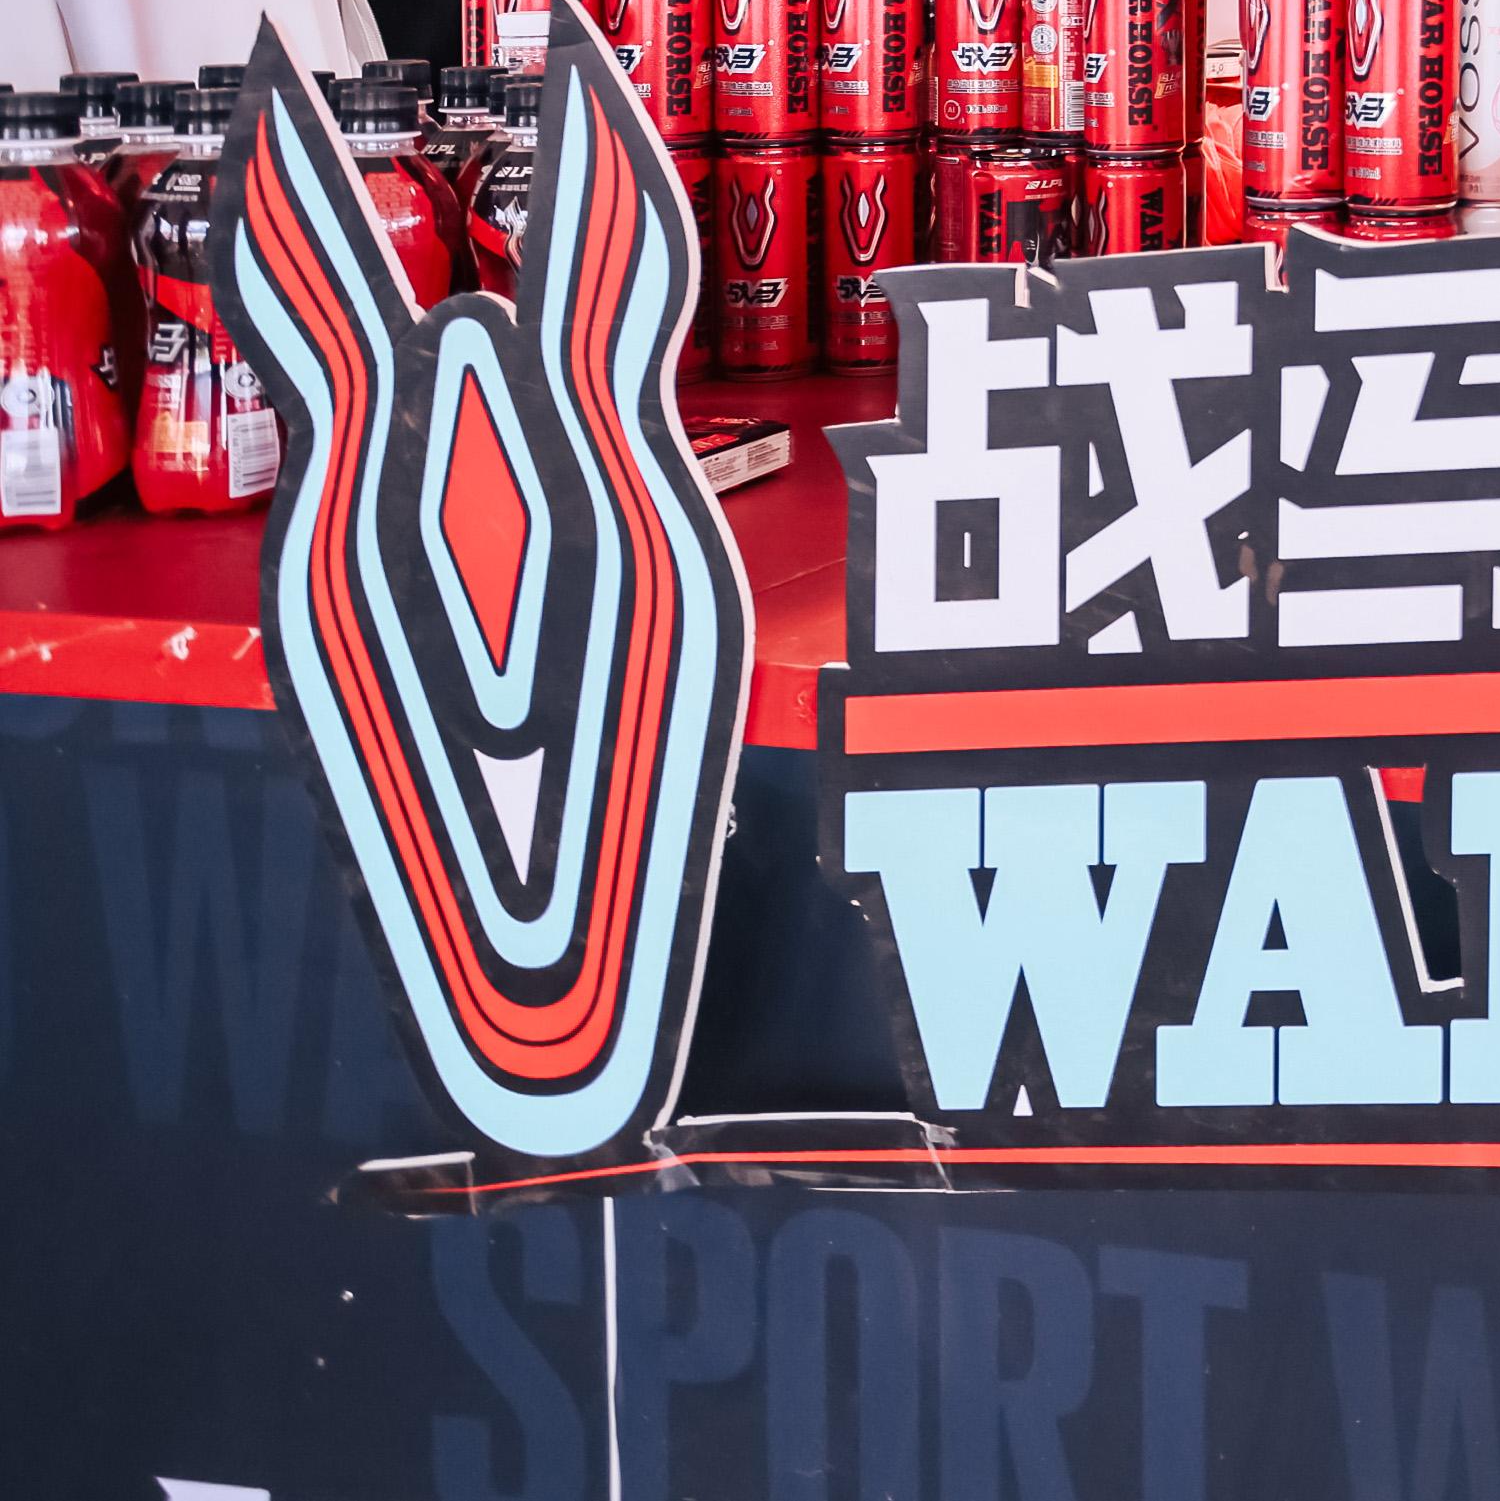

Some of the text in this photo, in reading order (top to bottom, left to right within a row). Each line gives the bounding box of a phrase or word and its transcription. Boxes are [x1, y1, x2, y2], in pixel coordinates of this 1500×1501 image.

[666, 17, 692, 117] HORSE
[787, 15, 809, 116] HORSE
[883, 17, 907, 114] HORSE
[1127, 20, 1154, 127] HORSE
[1302, 50, 1332, 172] HORSE
[1417, 55, 1445, 177] HORSE
